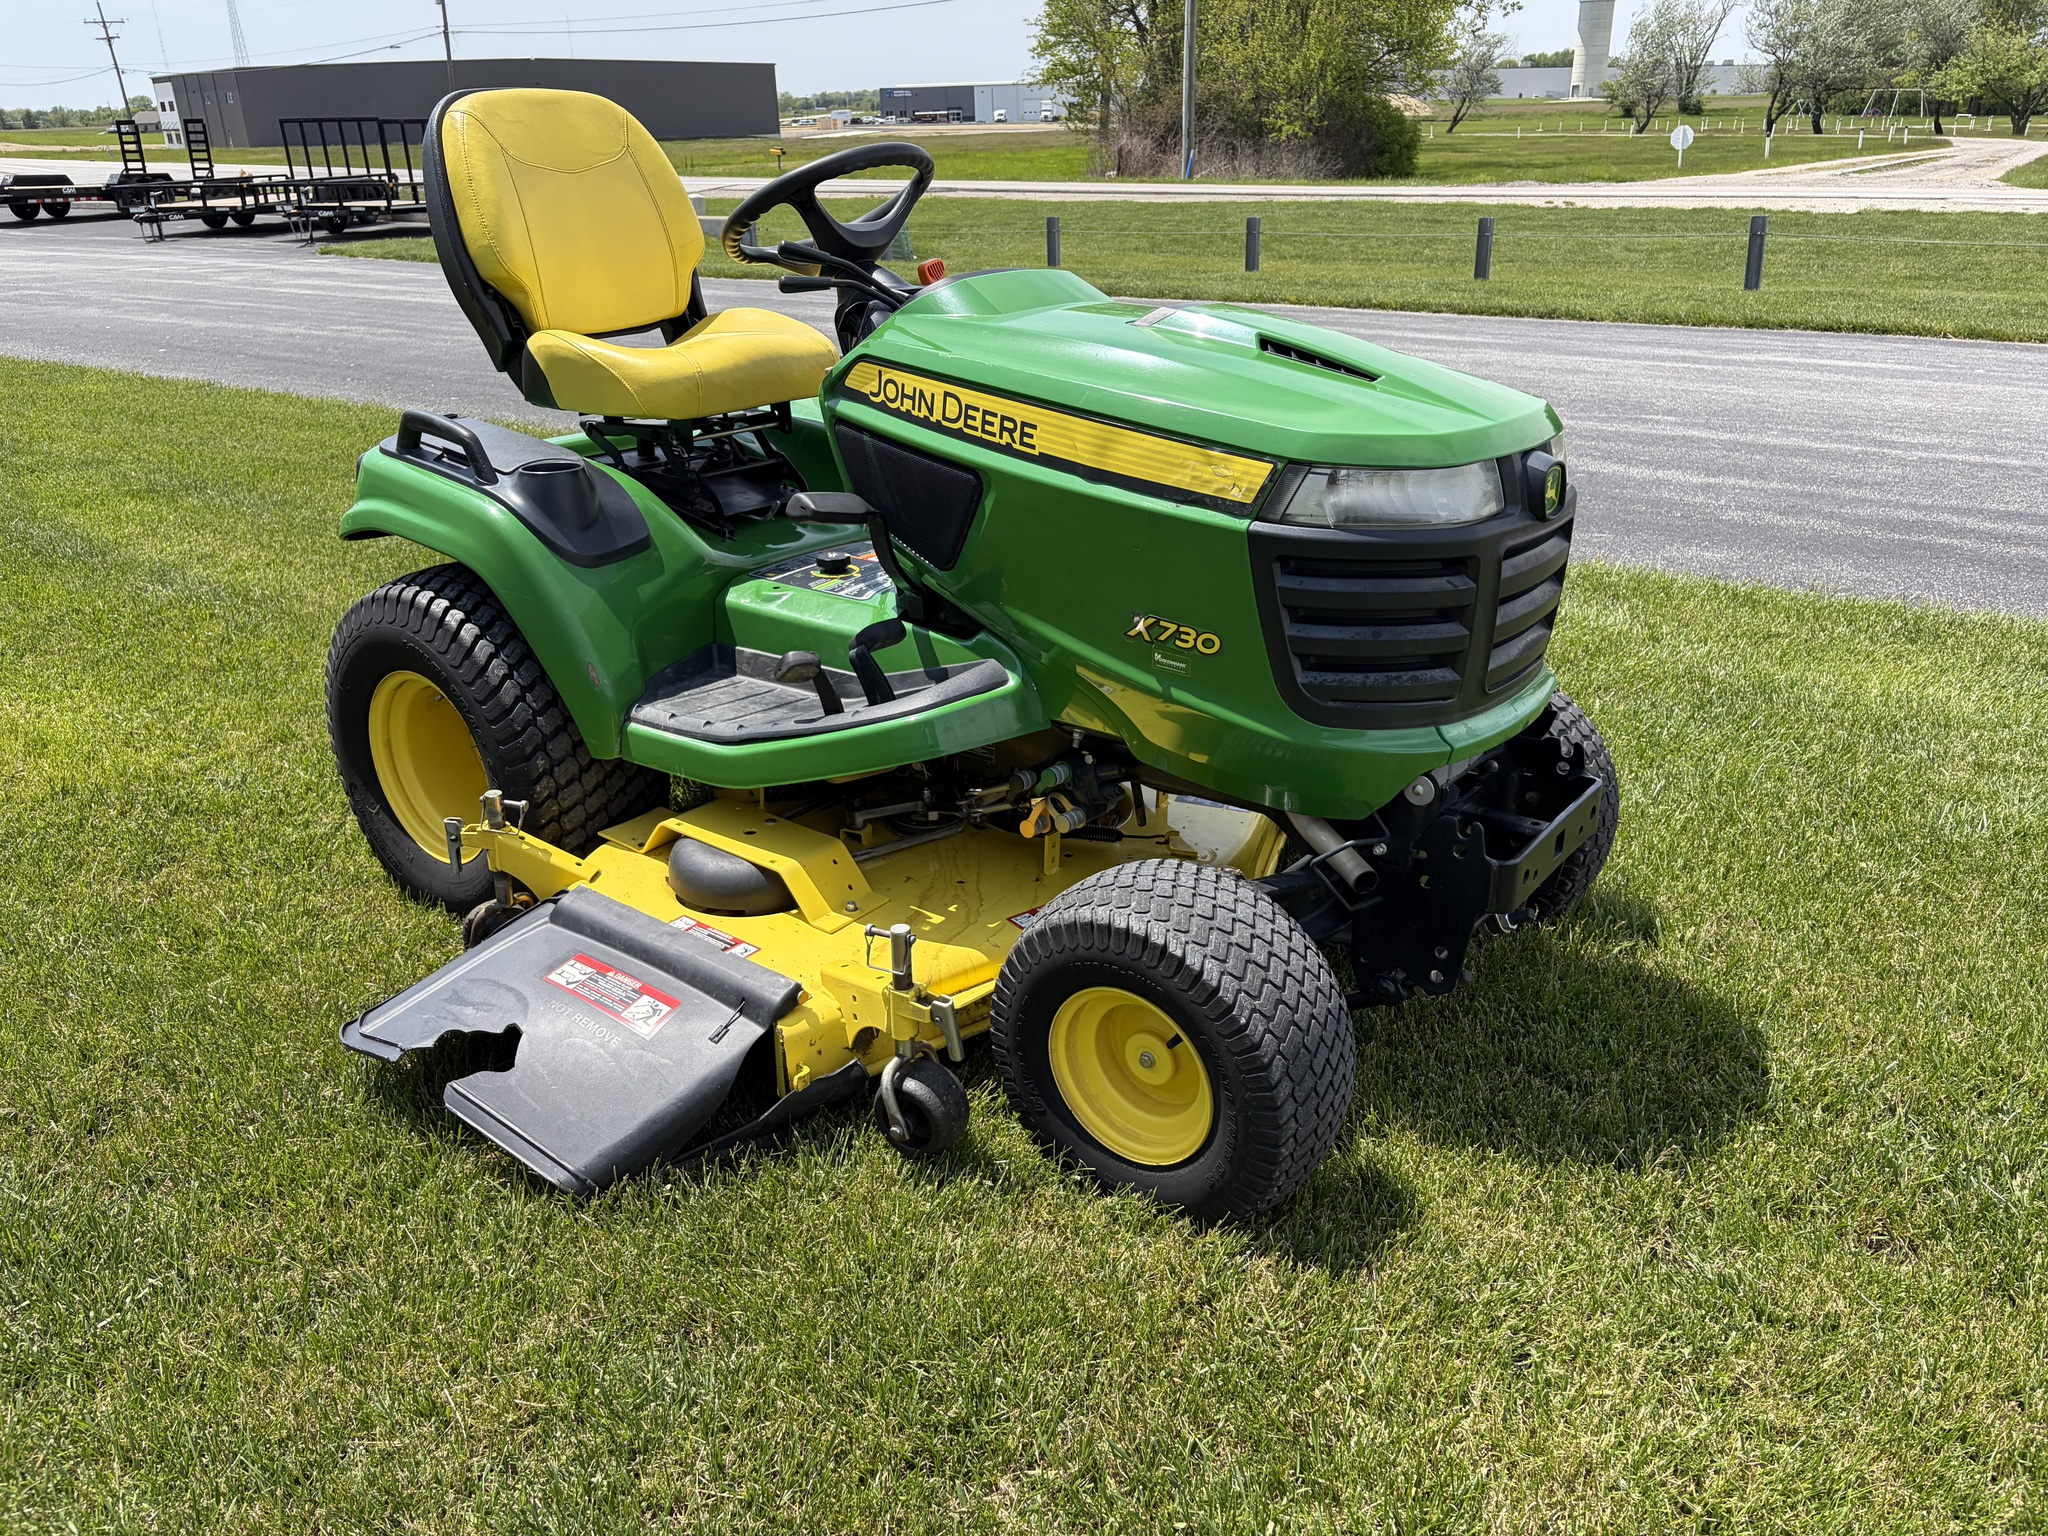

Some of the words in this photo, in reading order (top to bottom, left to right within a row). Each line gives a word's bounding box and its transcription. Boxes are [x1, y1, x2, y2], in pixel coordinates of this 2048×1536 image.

[62, 187, 77, 195] CAM
[869, 369, 937, 422] JOHN
[941, 390, 1038, 451] DEERE
[1125, 616, 1221, 655] X730
[614, 973, 643, 990] DANGER
[547, 999, 574, 1016] NOT
[571, 1012, 622, 1048] REMOVE
